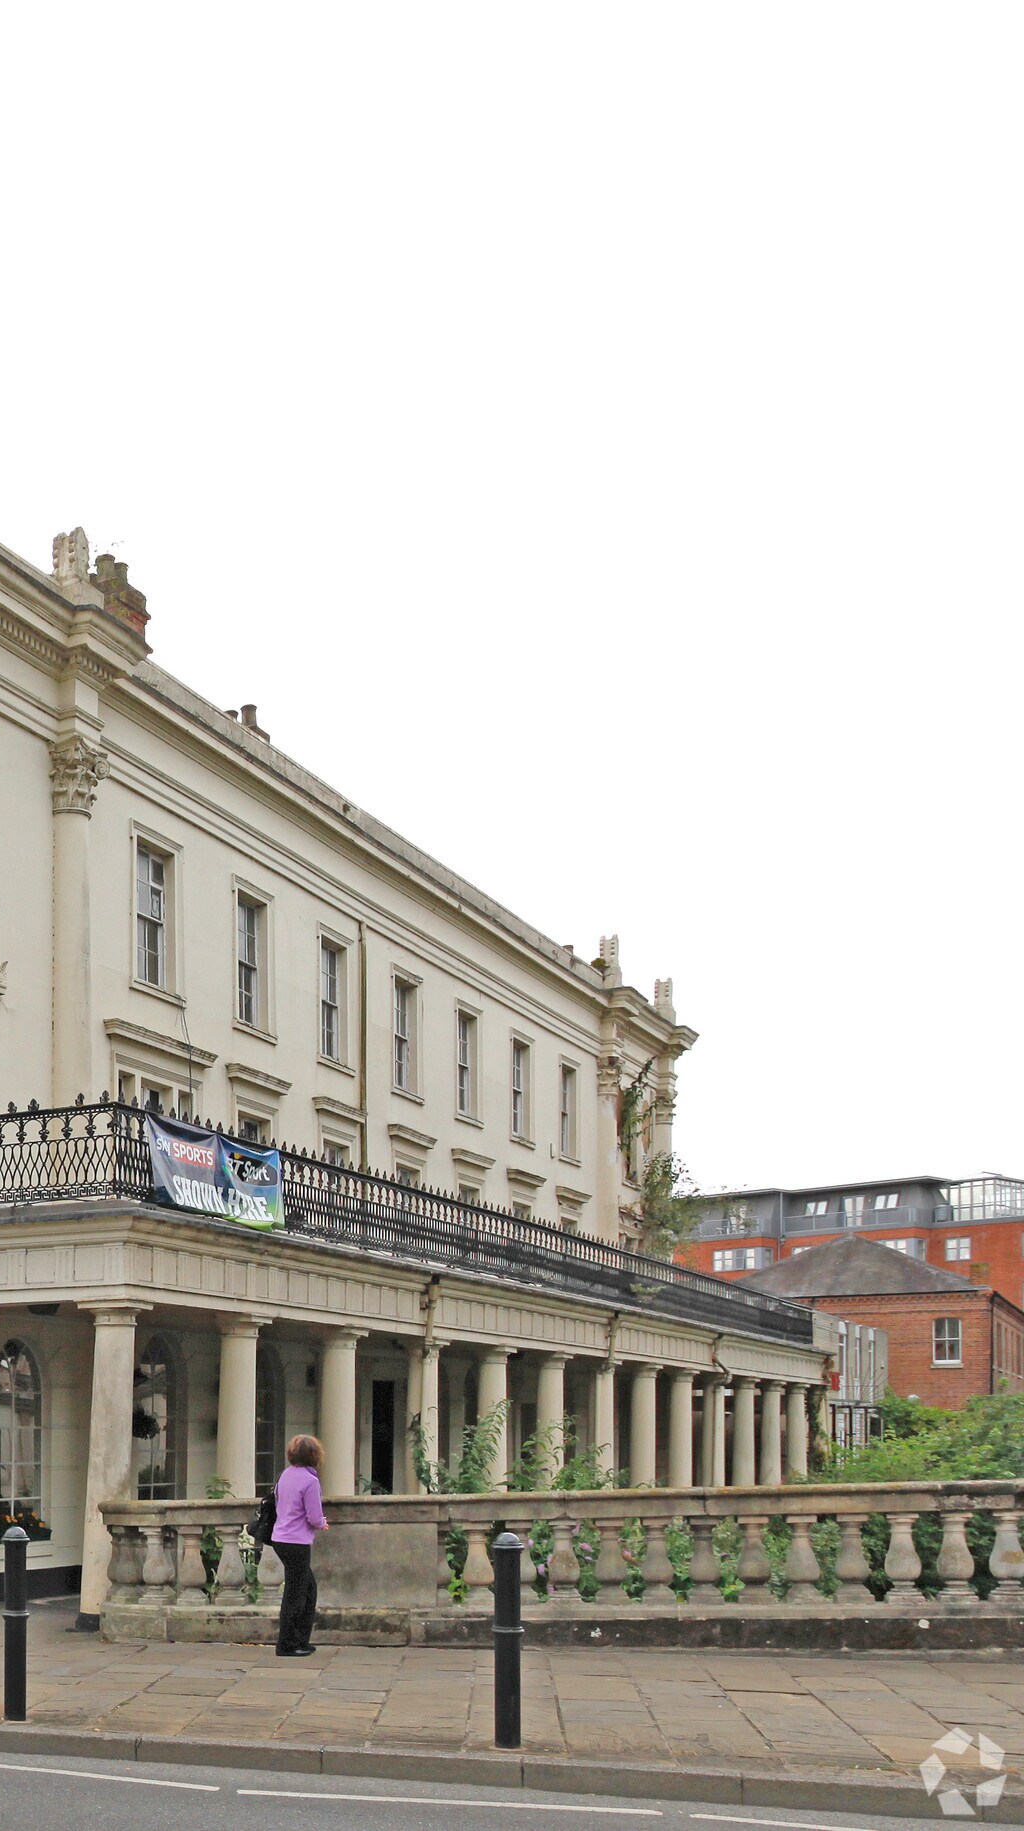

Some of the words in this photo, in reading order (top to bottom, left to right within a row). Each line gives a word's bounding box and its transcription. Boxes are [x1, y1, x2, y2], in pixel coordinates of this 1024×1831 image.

[173, 1142, 214, 1166] SPORTS
[226, 1157, 244, 1175] BT
[242, 1160, 270, 1182] Sport
[172, 1174, 229, 1214] SHOWN
